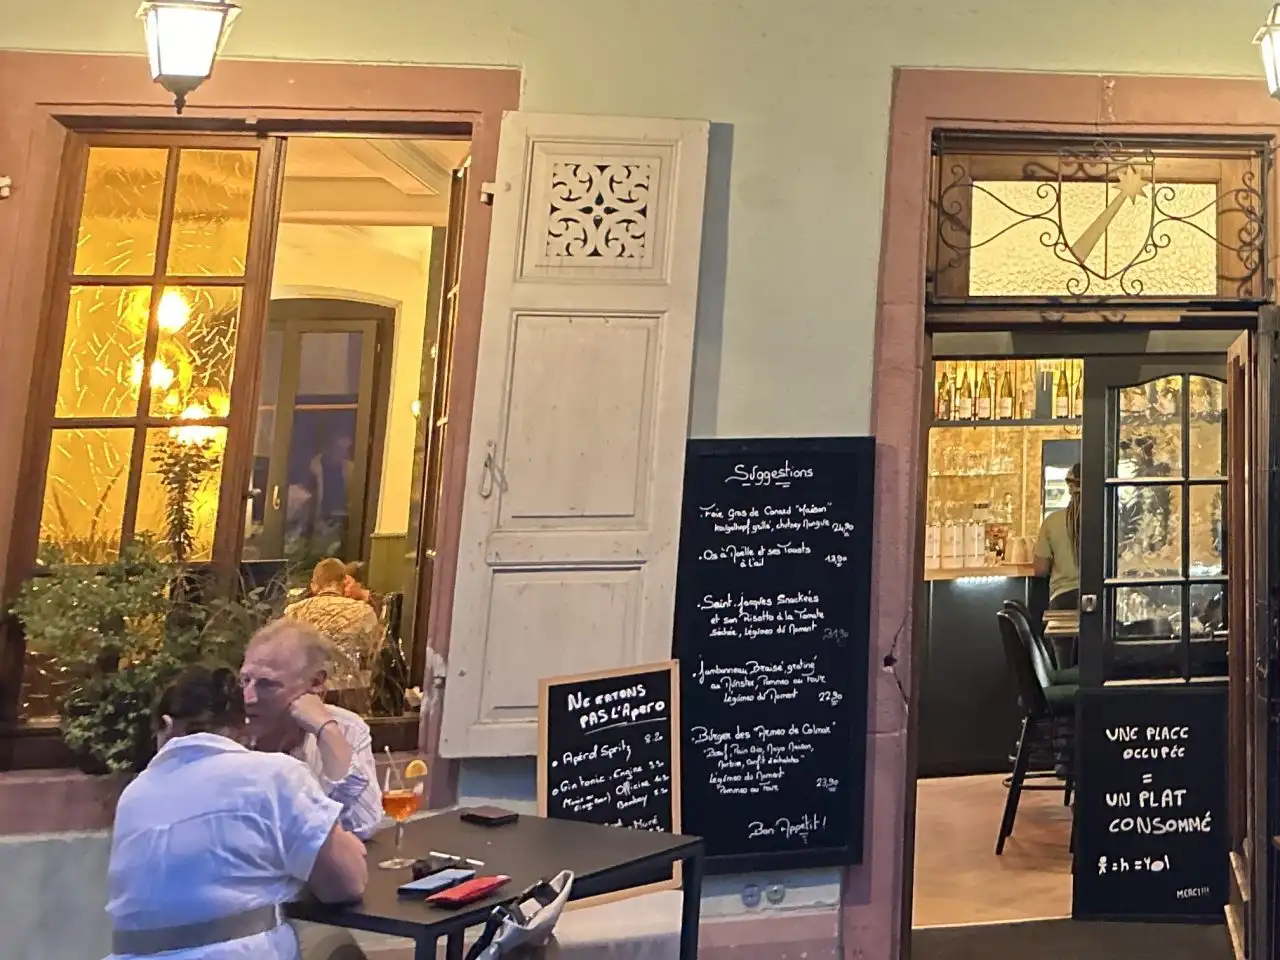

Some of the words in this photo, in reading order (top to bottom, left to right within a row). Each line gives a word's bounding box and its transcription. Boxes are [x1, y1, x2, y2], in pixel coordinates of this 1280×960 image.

[725, 460, 814, 486] Suggestions
[749, 506, 759, 517] de
[758, 545, 767, 556] et
[710, 613, 720, 625] et
[723, 616, 738, 624] son
[580, 709, 609, 729] PAS
[734, 724, 751, 740] des
[788, 723, 799, 735] de
[1105, 791, 1131, 807] UN
[1138, 789, 1187, 809] PLAT
[748, 821, 775, 839] Bon
[1108, 810, 1212, 835] CONSOMMÉ
